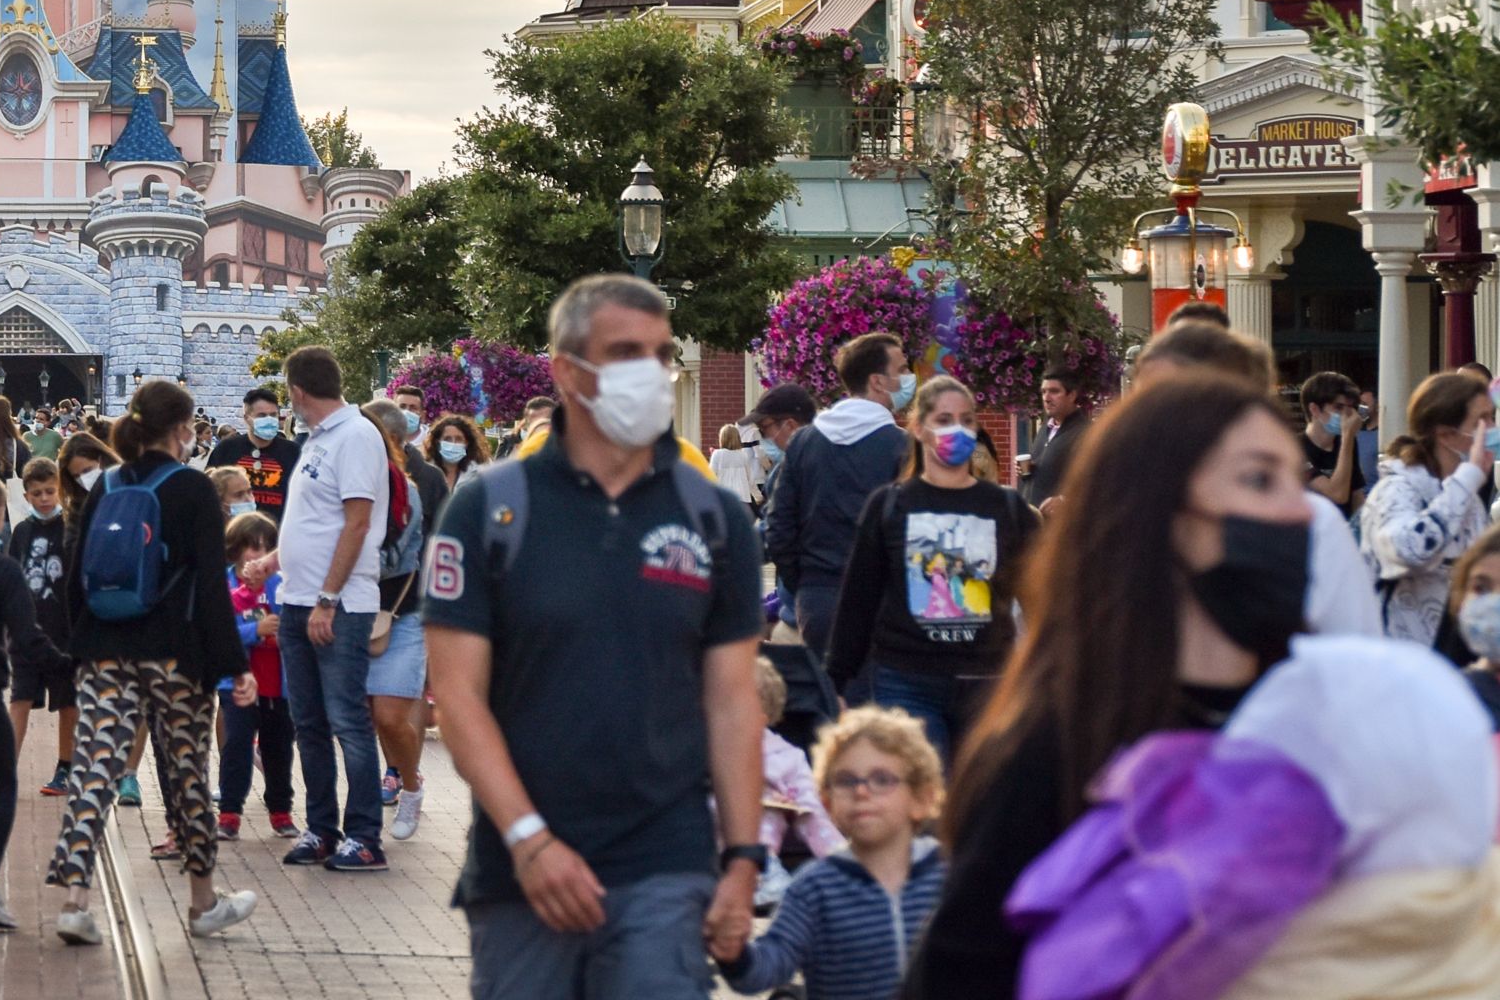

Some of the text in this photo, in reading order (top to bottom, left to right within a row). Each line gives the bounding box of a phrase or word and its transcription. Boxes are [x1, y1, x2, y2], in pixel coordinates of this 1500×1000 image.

[1262, 120, 1353, 142] MARKET HOUSE
[928, 629, 977, 642] CREW
